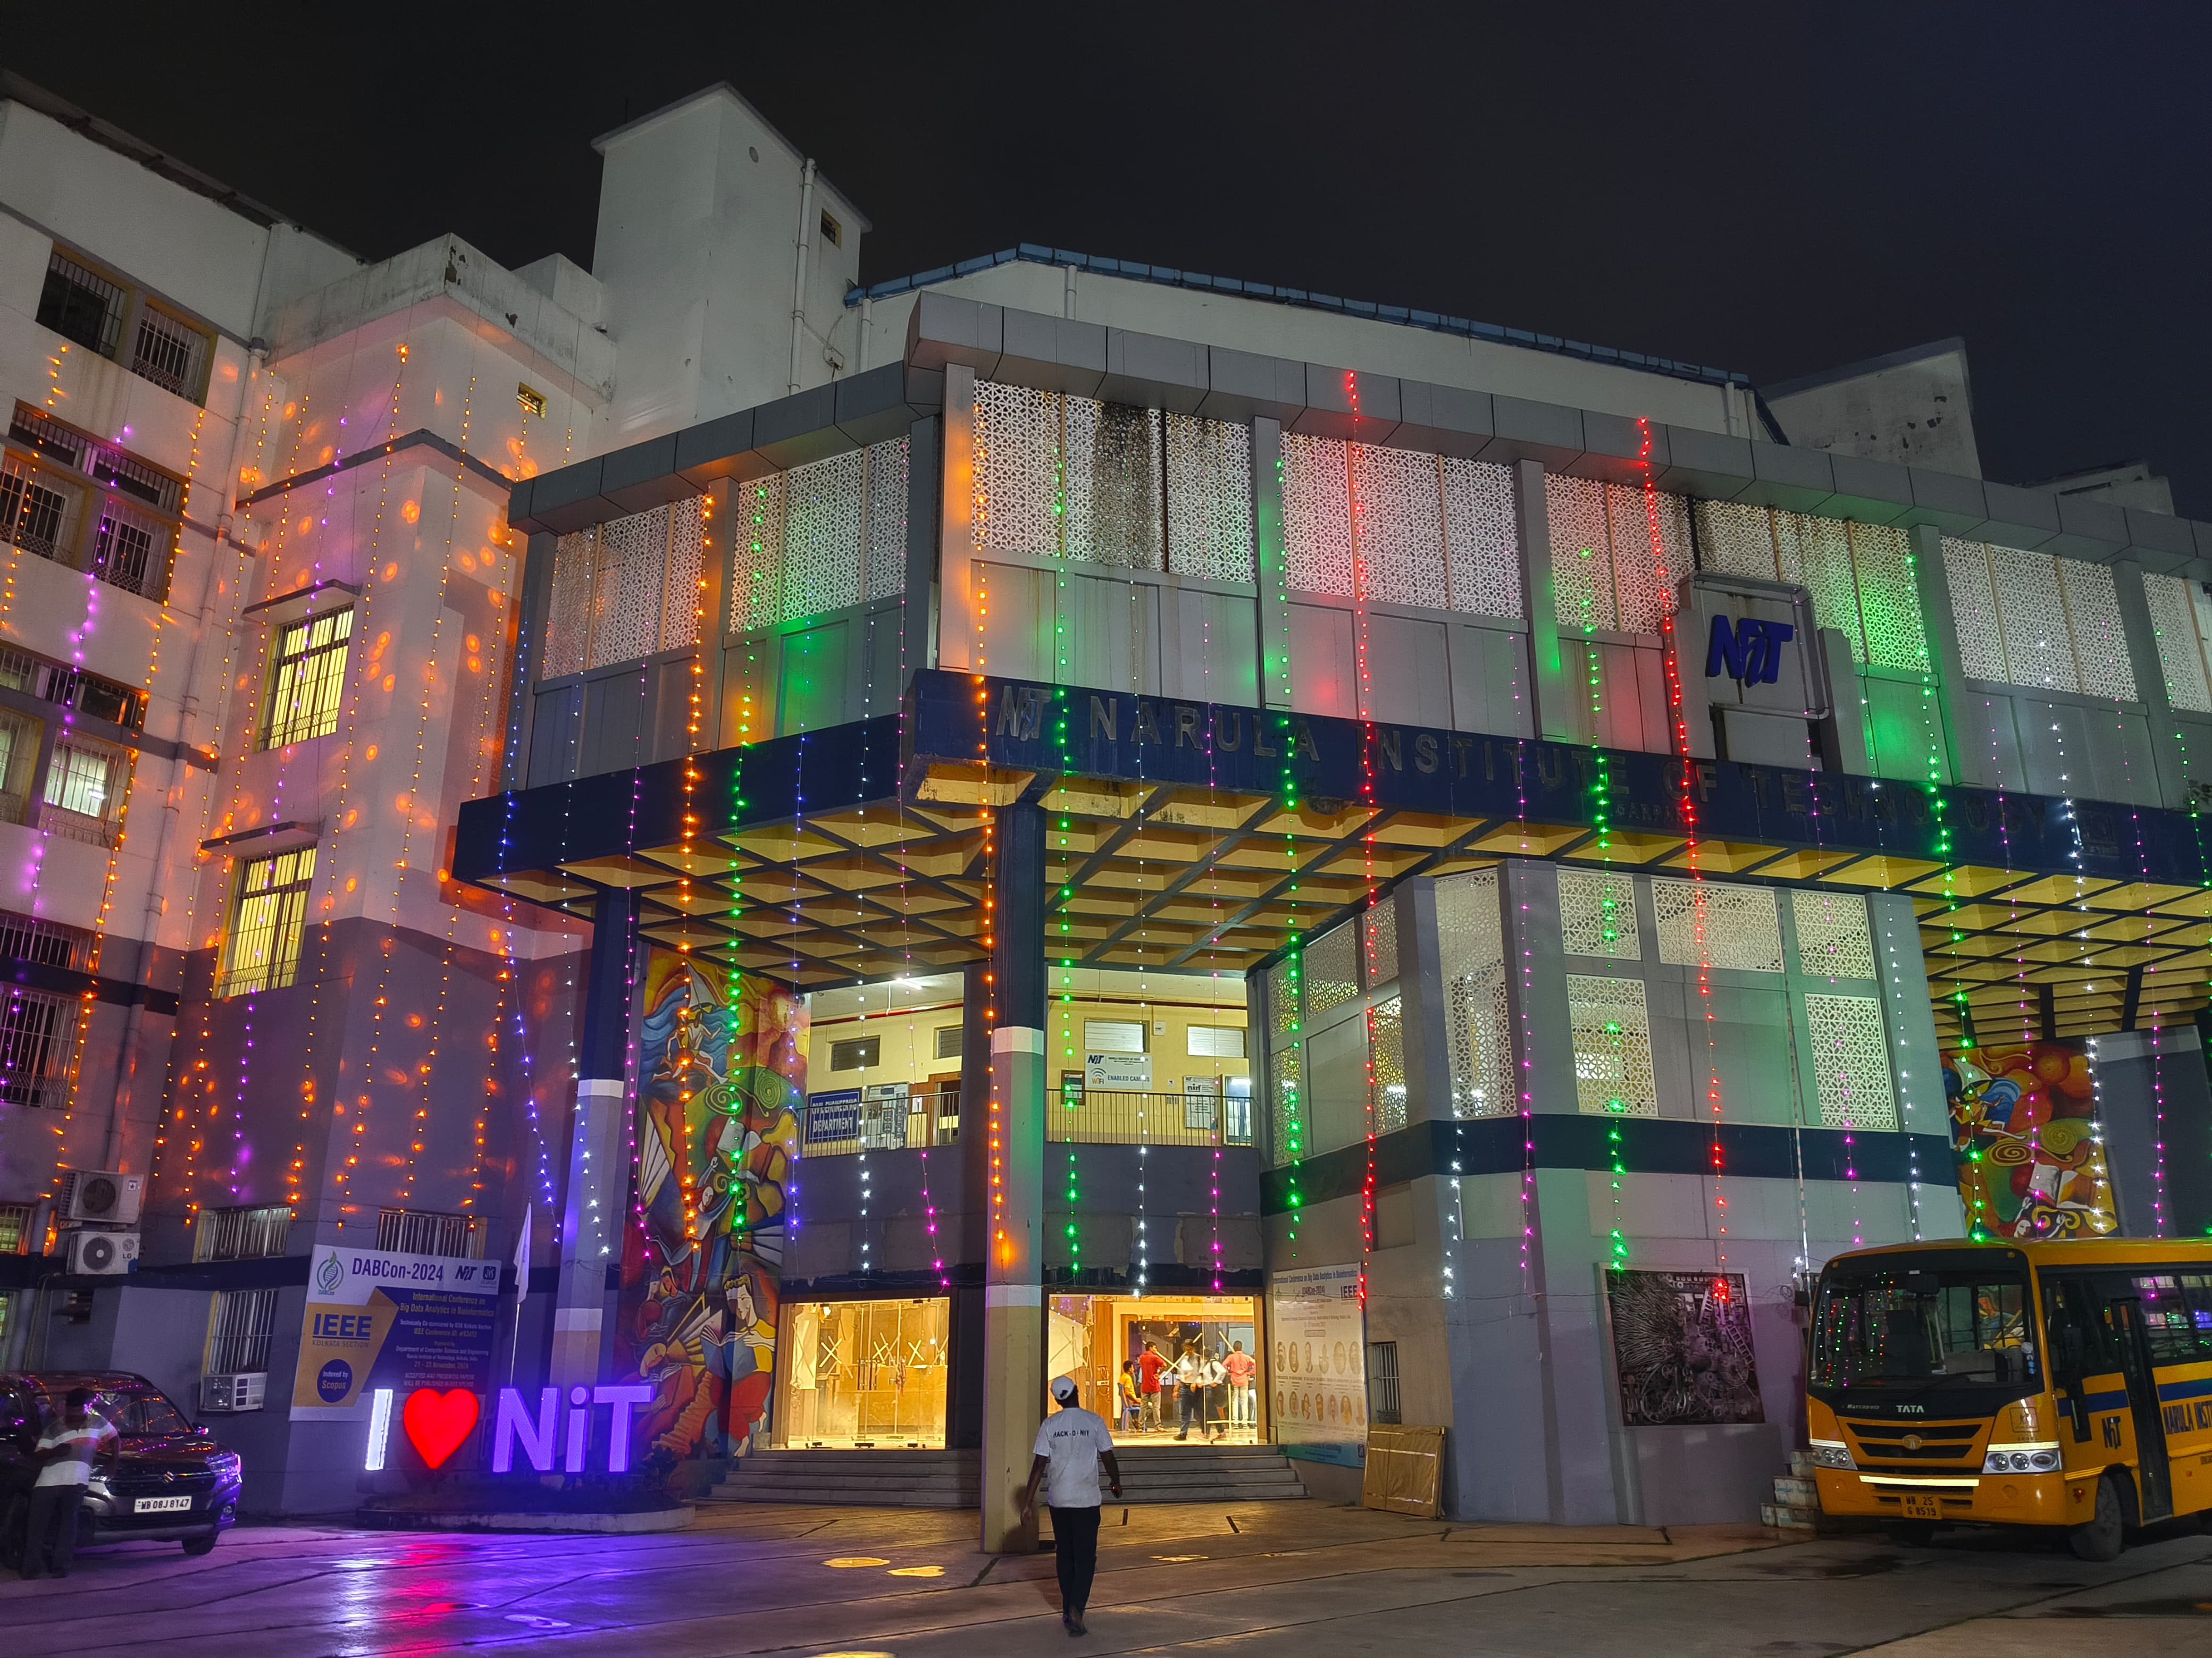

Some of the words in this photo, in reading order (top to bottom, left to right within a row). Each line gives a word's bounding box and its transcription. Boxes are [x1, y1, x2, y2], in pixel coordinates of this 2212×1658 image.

[1090, 695, 1320, 762] NARULA
[1356, 726, 1630, 795] INSTITUTE
[1663, 760, 1717, 803] OF
[812, 1102, 823, 1115] CIVIL
[825, 1098, 857, 1114] ENGINEERING
[812, 1116, 853, 1133] DEPARTMENT
[352, 1258, 443, 1282] DABCon-2024
[413, 1292, 448, 1302] International
[449, 1294, 477, 1304] Conference
[400, 1302, 409, 1312] Big
[411, 1303, 424, 1312] Data
[425, 1304, 449, 1314] Analytics
[313, 1313, 372, 1337] IEEE
[342, 1371, 349, 1379] by
[322, 1380, 346, 1391] Scopus
[2163, 1403, 2194, 1435] NARULA
[365, 1388, 393, 1470] I
[492, 1386, 655, 1472] NiT
[1923, 1496, 1934, 1505] 25
